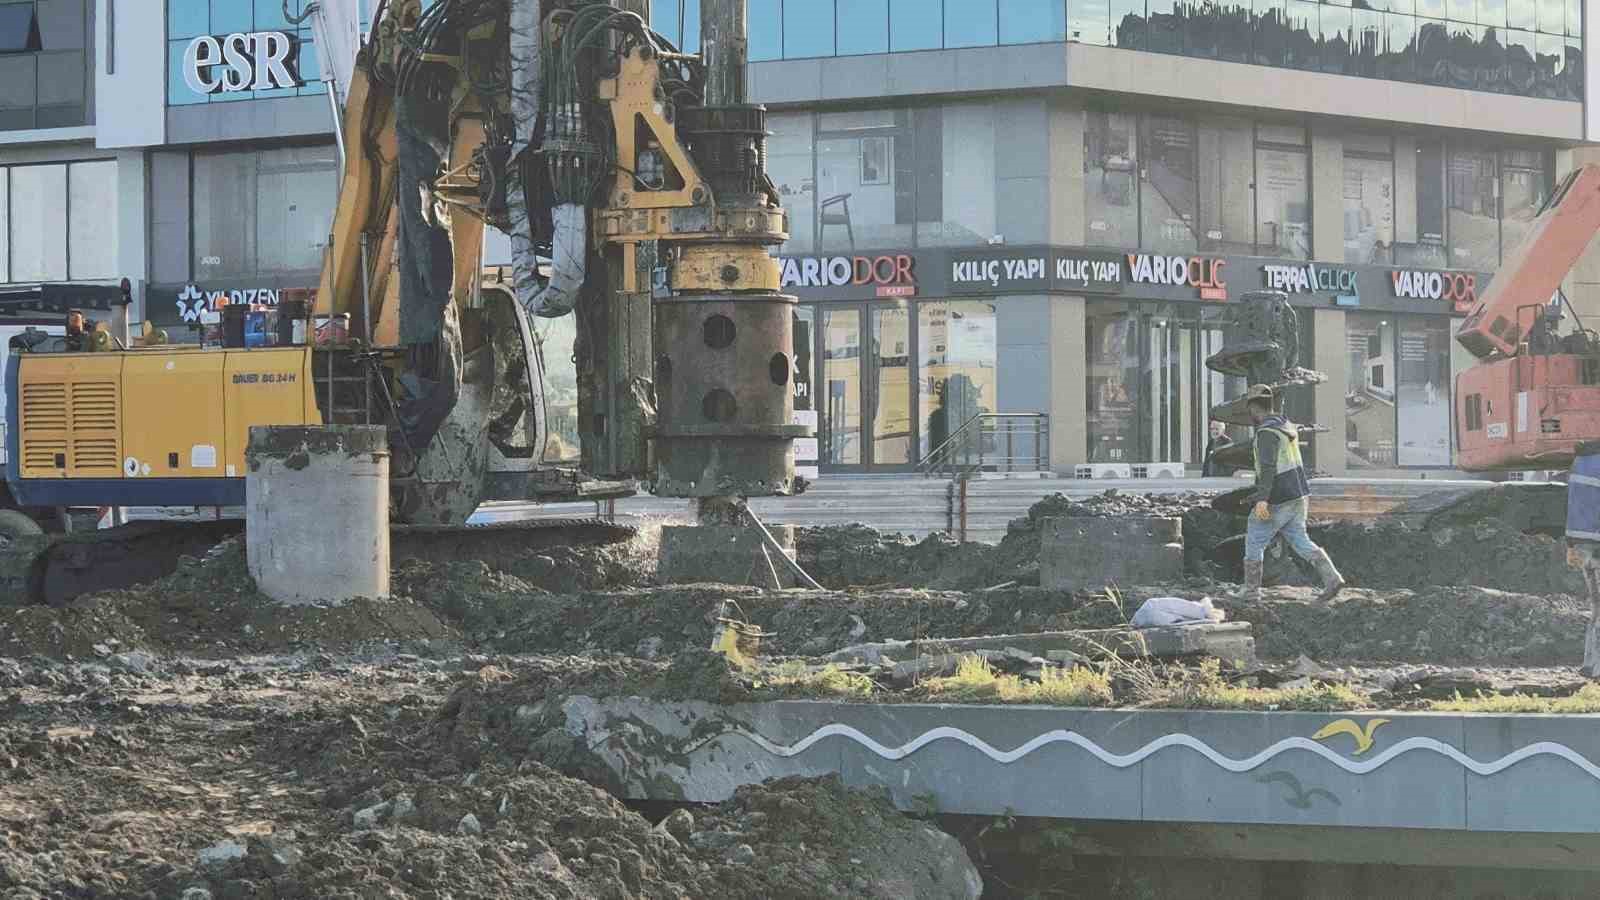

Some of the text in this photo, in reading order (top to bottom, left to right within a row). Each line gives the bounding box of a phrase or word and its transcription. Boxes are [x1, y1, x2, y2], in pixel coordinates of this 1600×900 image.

[952, 258, 1045, 287] KILIÇ YAPI
[1056, 258, 1120, 287] KILIÇ YAPI
[1128, 254, 1227, 289] VARIOCLIC
[1392, 270, 1477, 301] VARIODOR
